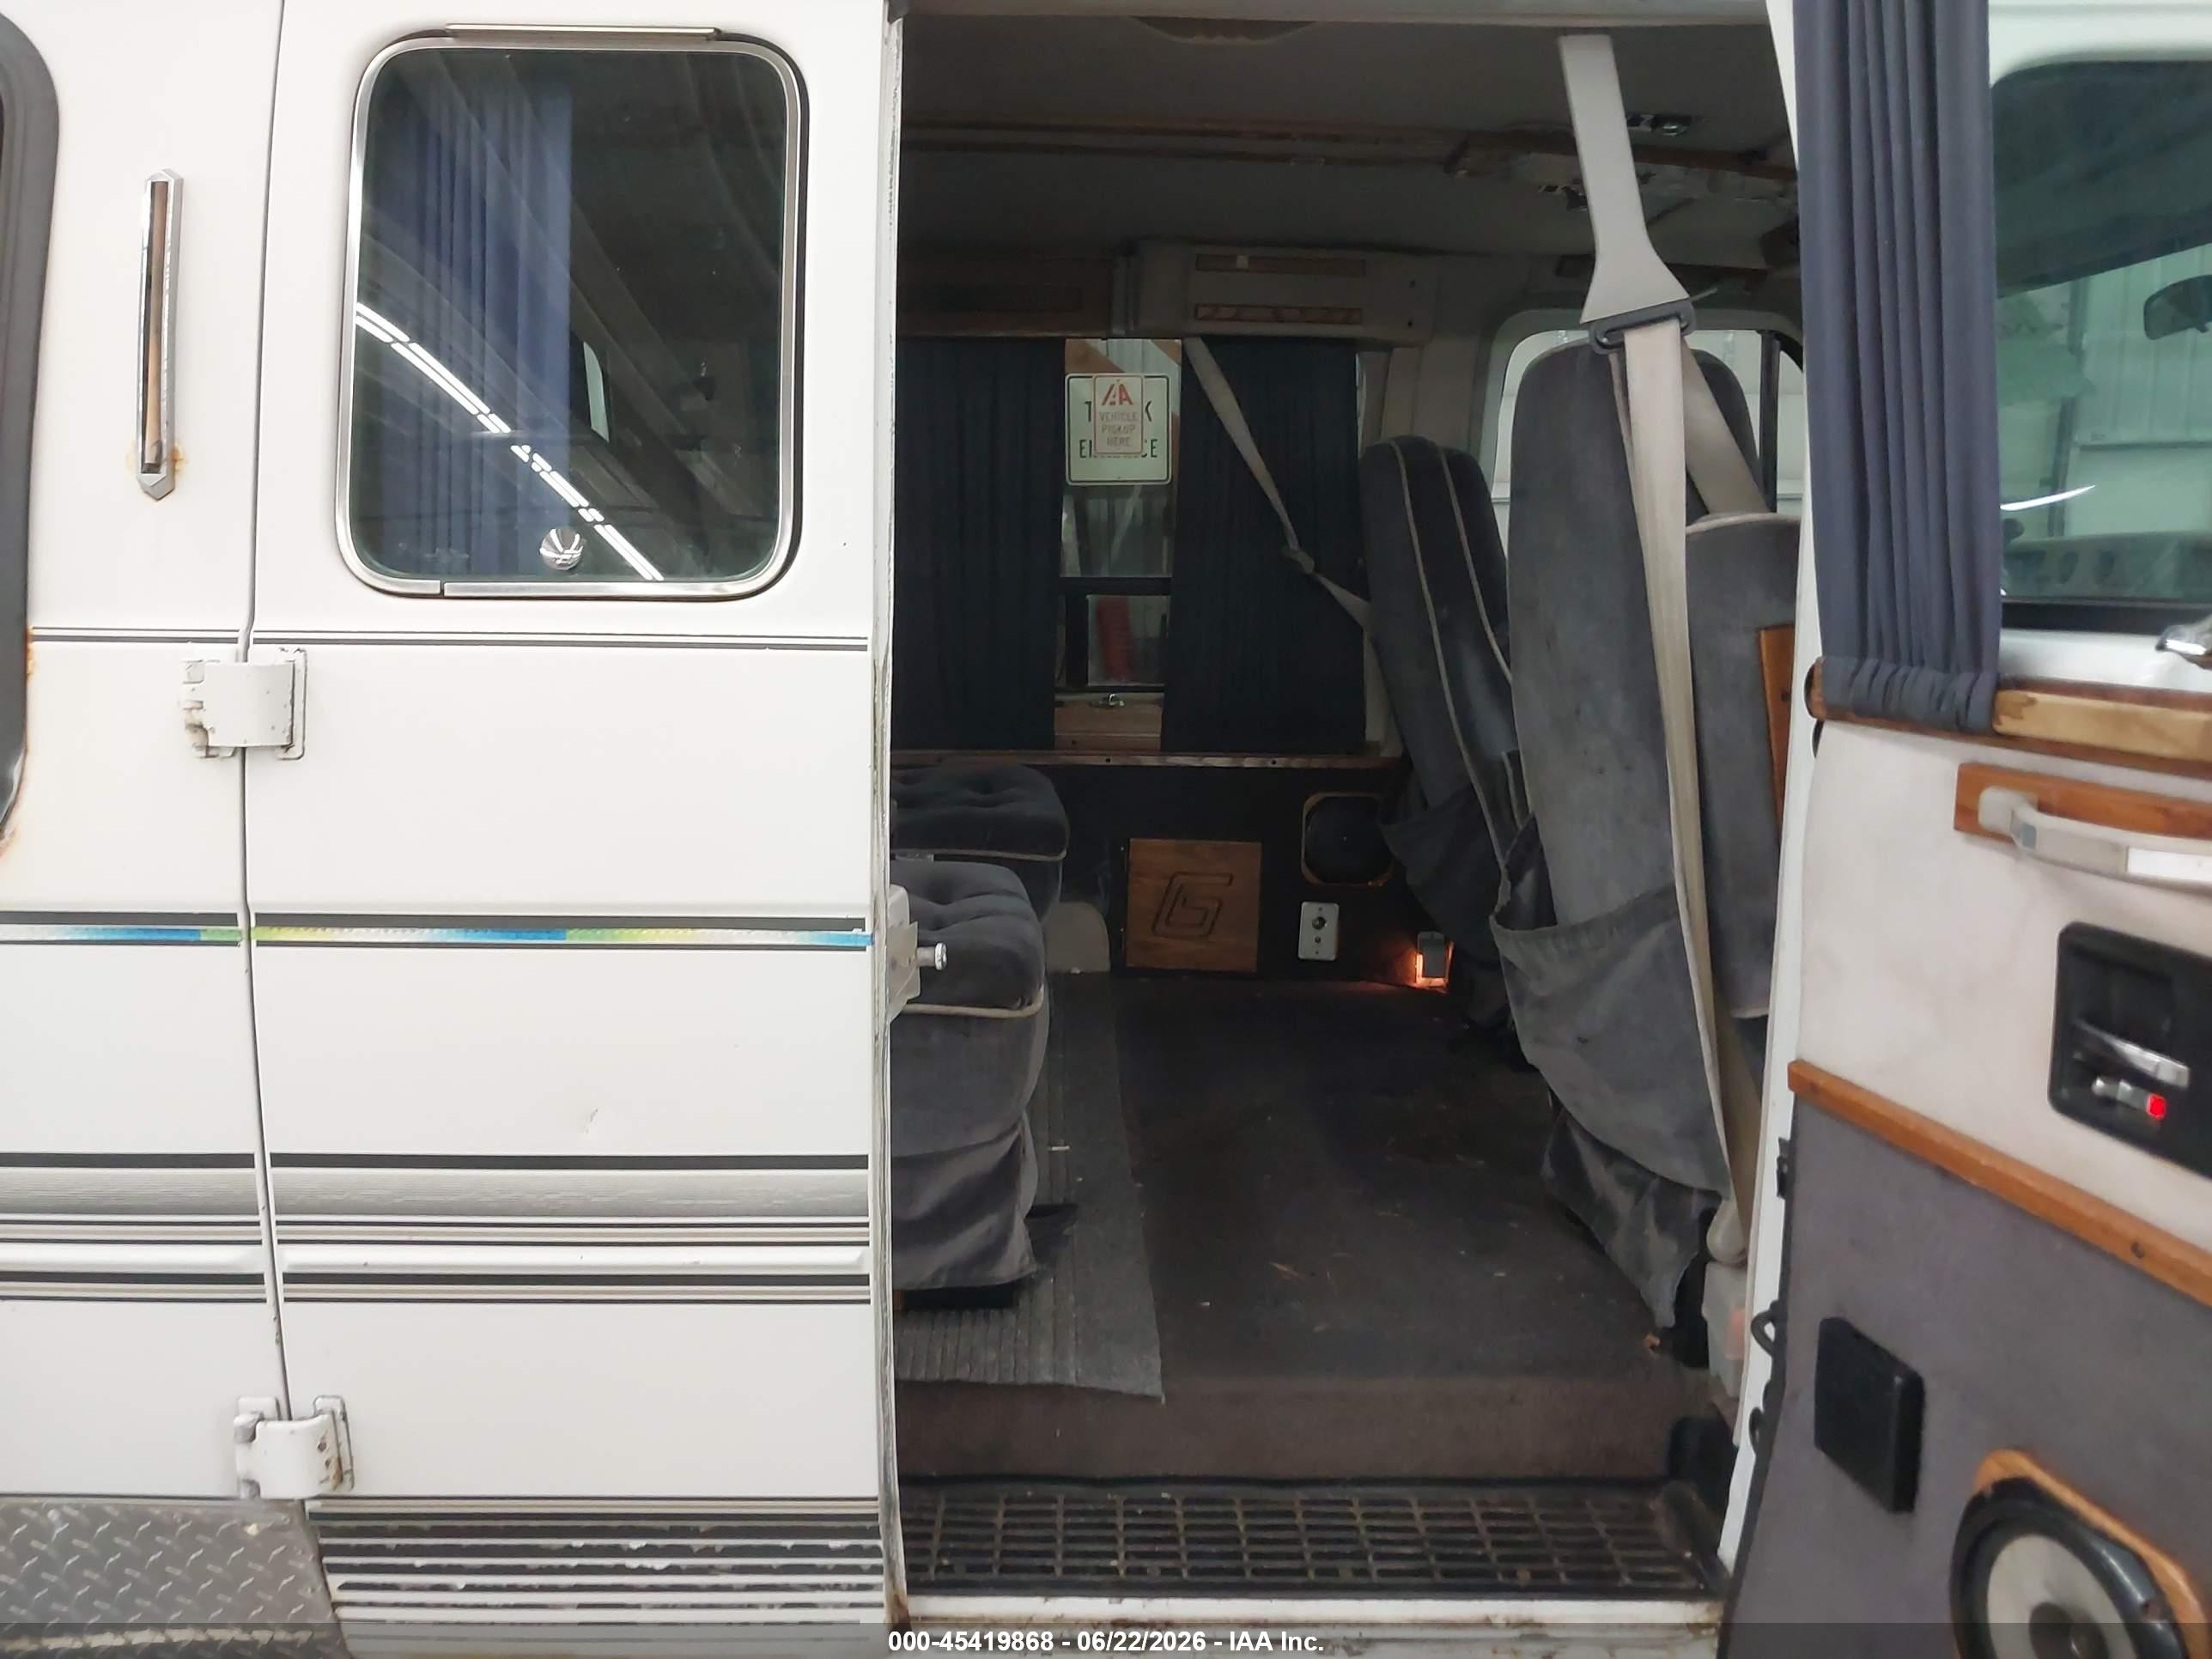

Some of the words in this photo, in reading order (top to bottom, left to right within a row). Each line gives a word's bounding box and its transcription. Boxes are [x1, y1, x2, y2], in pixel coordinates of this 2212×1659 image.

[1099, 411, 1138, 422] VEHICLE
[1102, 425, 1136, 434] PICKUP
[1107, 436, 1131, 447] HERE
